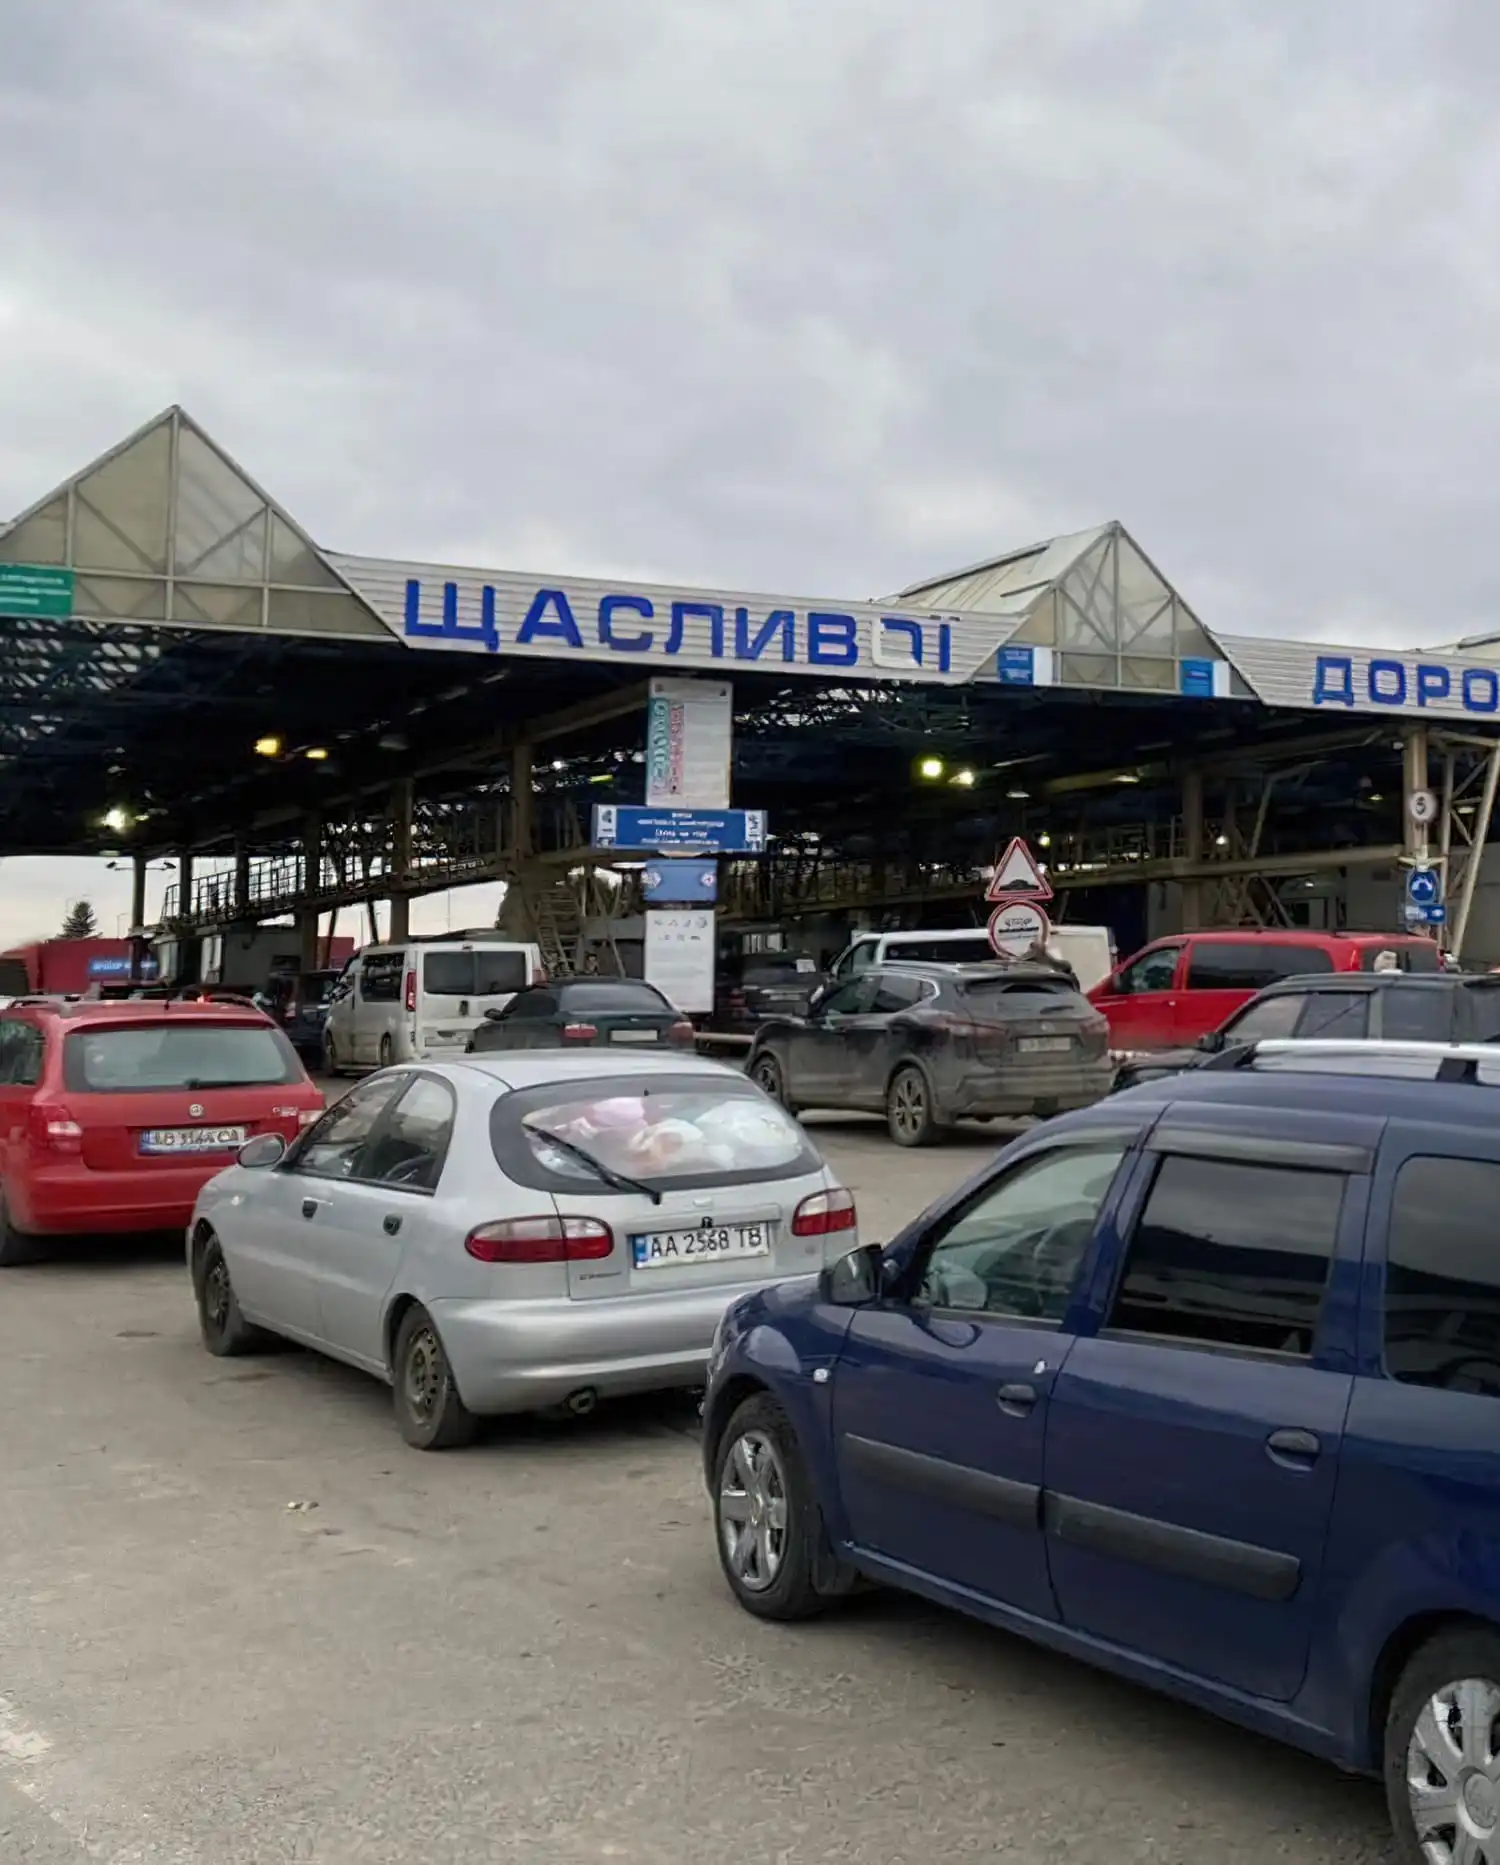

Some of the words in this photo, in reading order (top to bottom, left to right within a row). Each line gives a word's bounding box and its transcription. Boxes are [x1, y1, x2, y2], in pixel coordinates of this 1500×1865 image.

[651, 1234, 680, 1258] AA
[683, 1228, 730, 1255] 2568
[733, 1226, 763, 1248] TB
